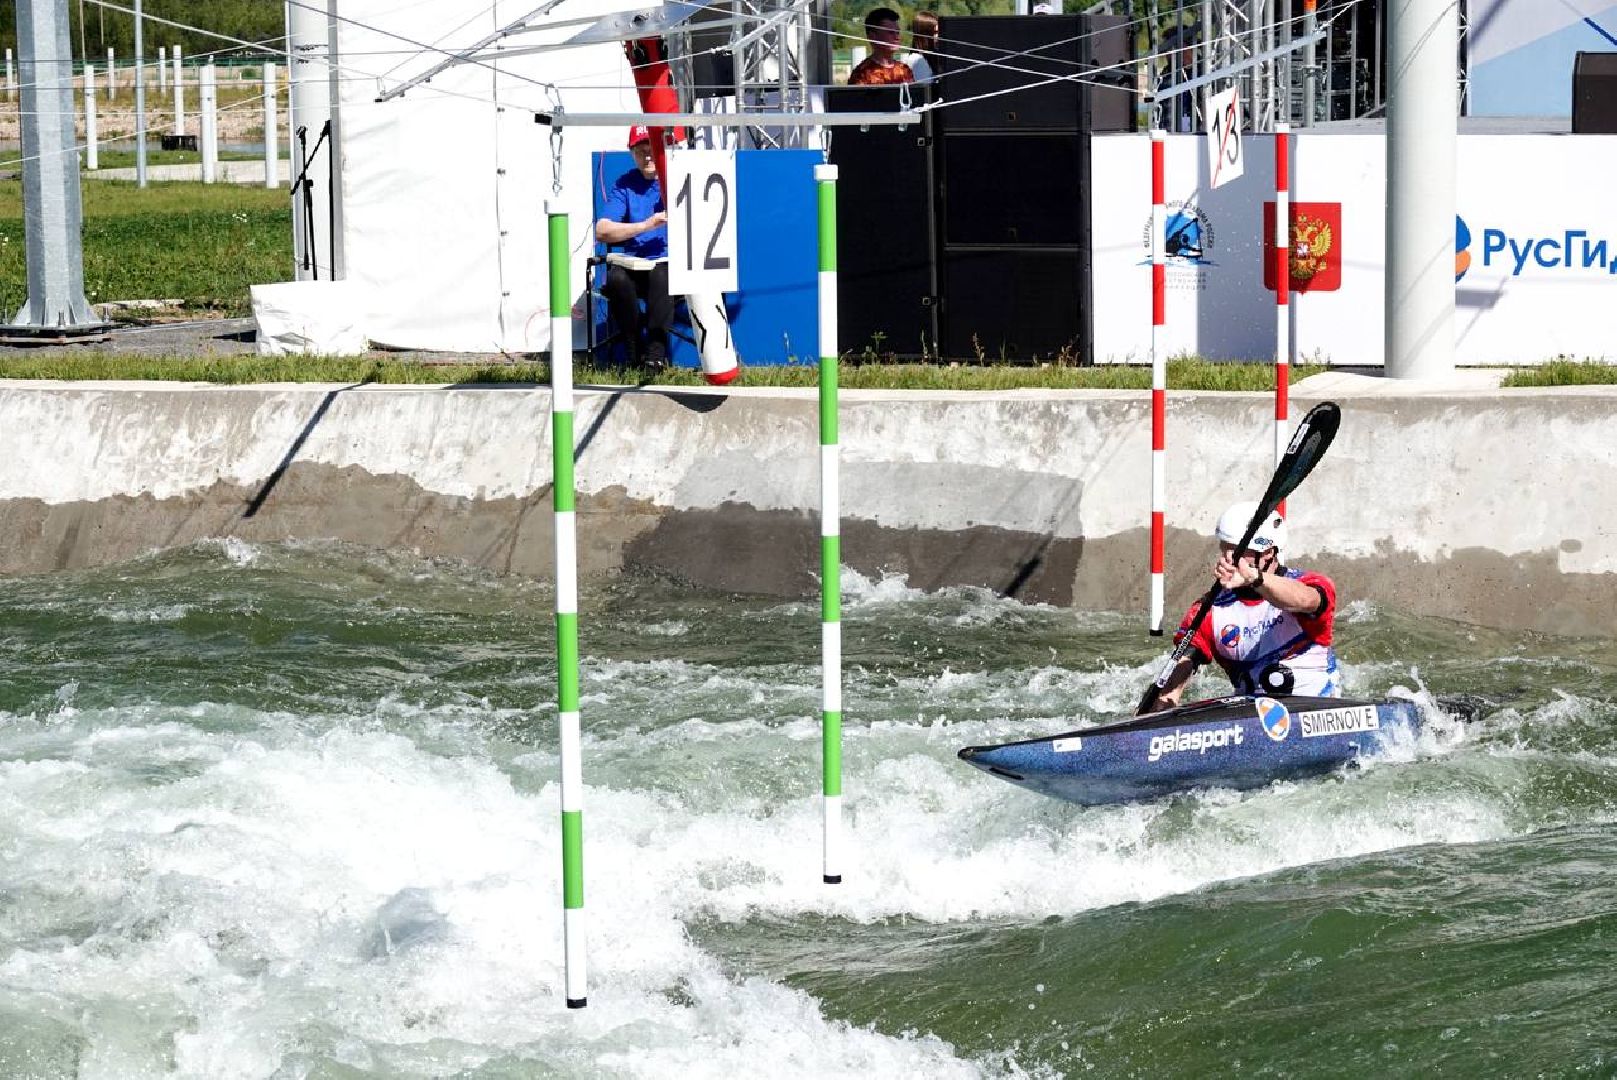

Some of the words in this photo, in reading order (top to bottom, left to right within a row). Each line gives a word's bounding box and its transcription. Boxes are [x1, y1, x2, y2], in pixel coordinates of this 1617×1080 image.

[1212, 103, 1239, 170] 13
[676, 173, 731, 270] 12
[1147, 724, 1244, 762] galasport
[1302, 709, 1361, 734] SMIRNOV
[1365, 708, 1377, 727] E.
